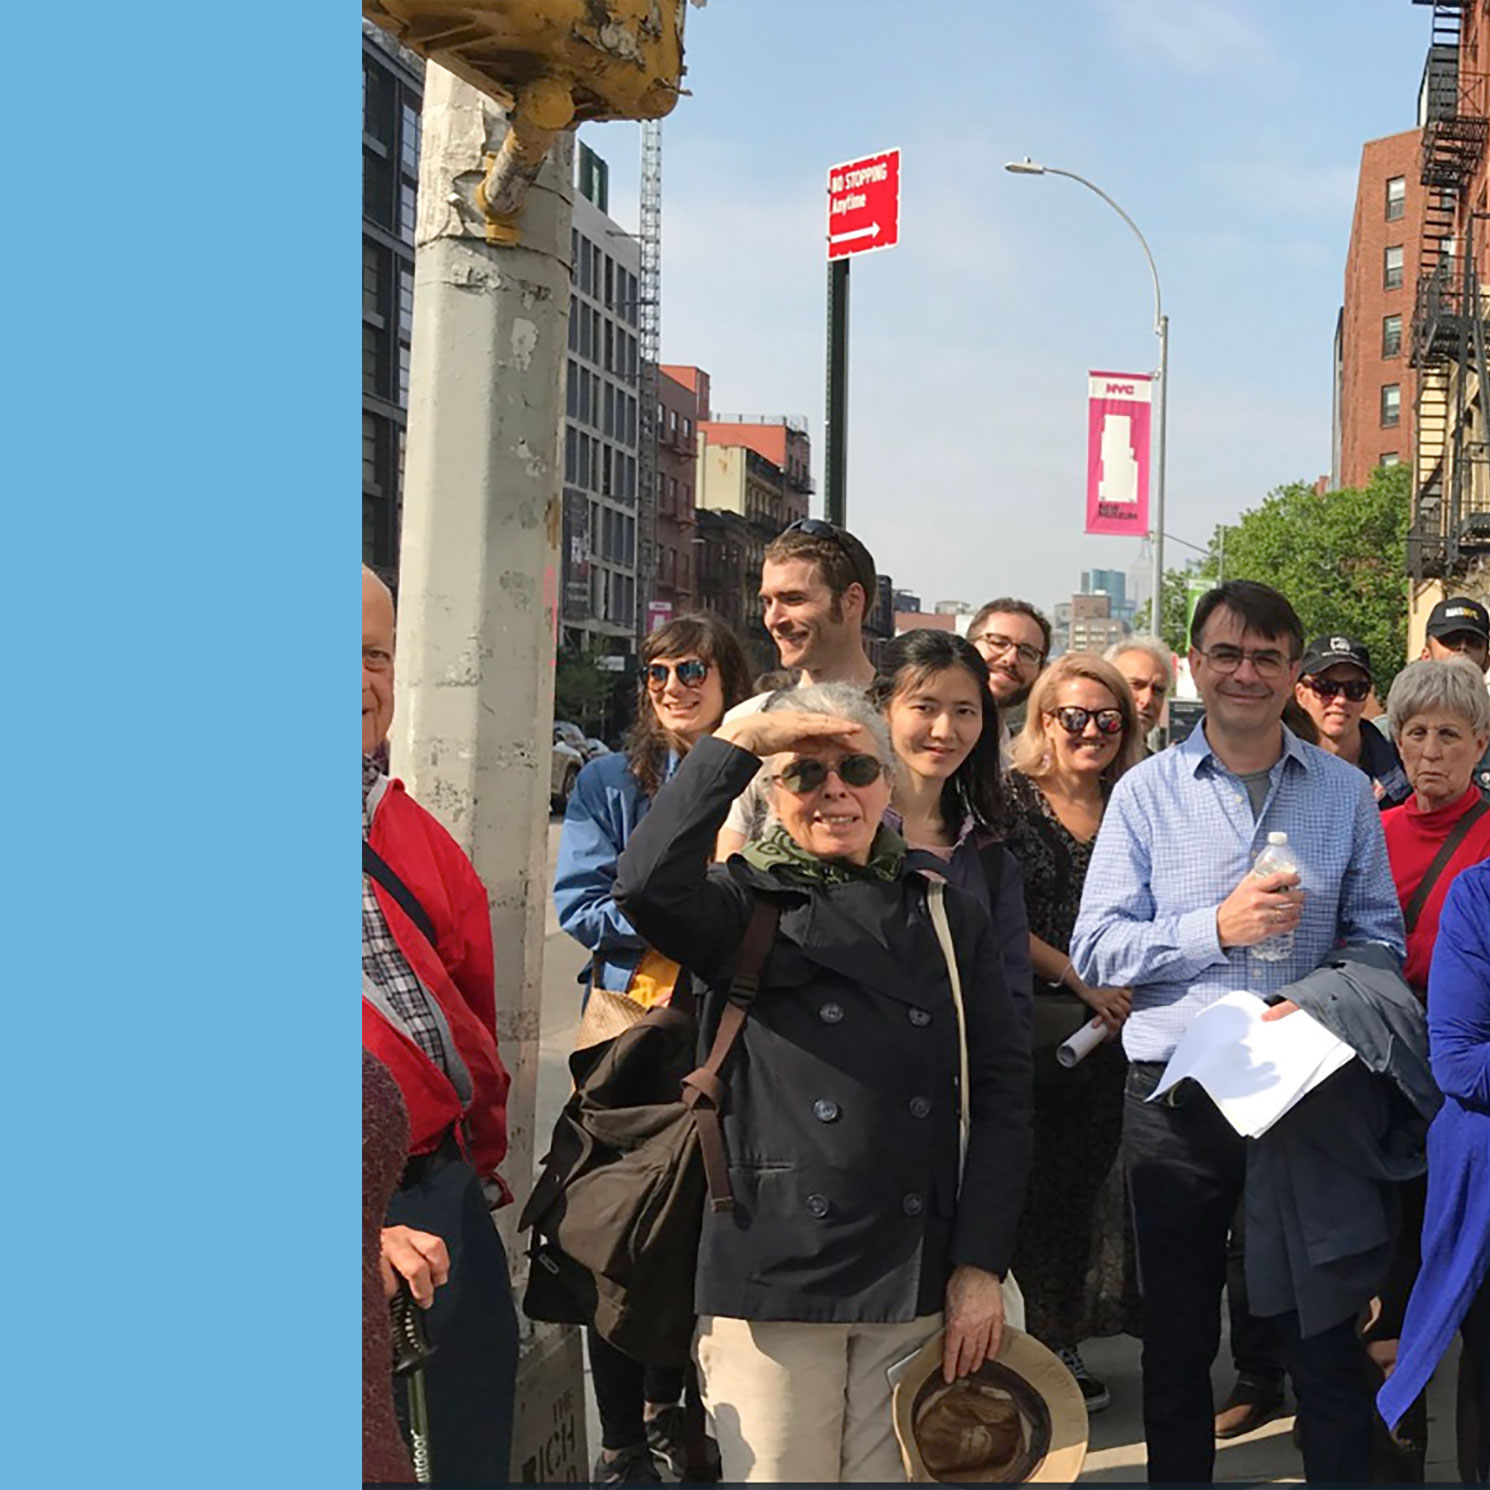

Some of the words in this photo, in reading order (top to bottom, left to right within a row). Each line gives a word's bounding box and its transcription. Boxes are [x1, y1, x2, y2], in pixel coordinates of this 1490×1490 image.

[831, 174, 844, 194] NO
[845, 162, 887, 190] STOPPING
[831, 192, 866, 216] Anytime
[1106, 383, 1134, 395] NYC
[410, 1428, 430, 1483] utdoor
